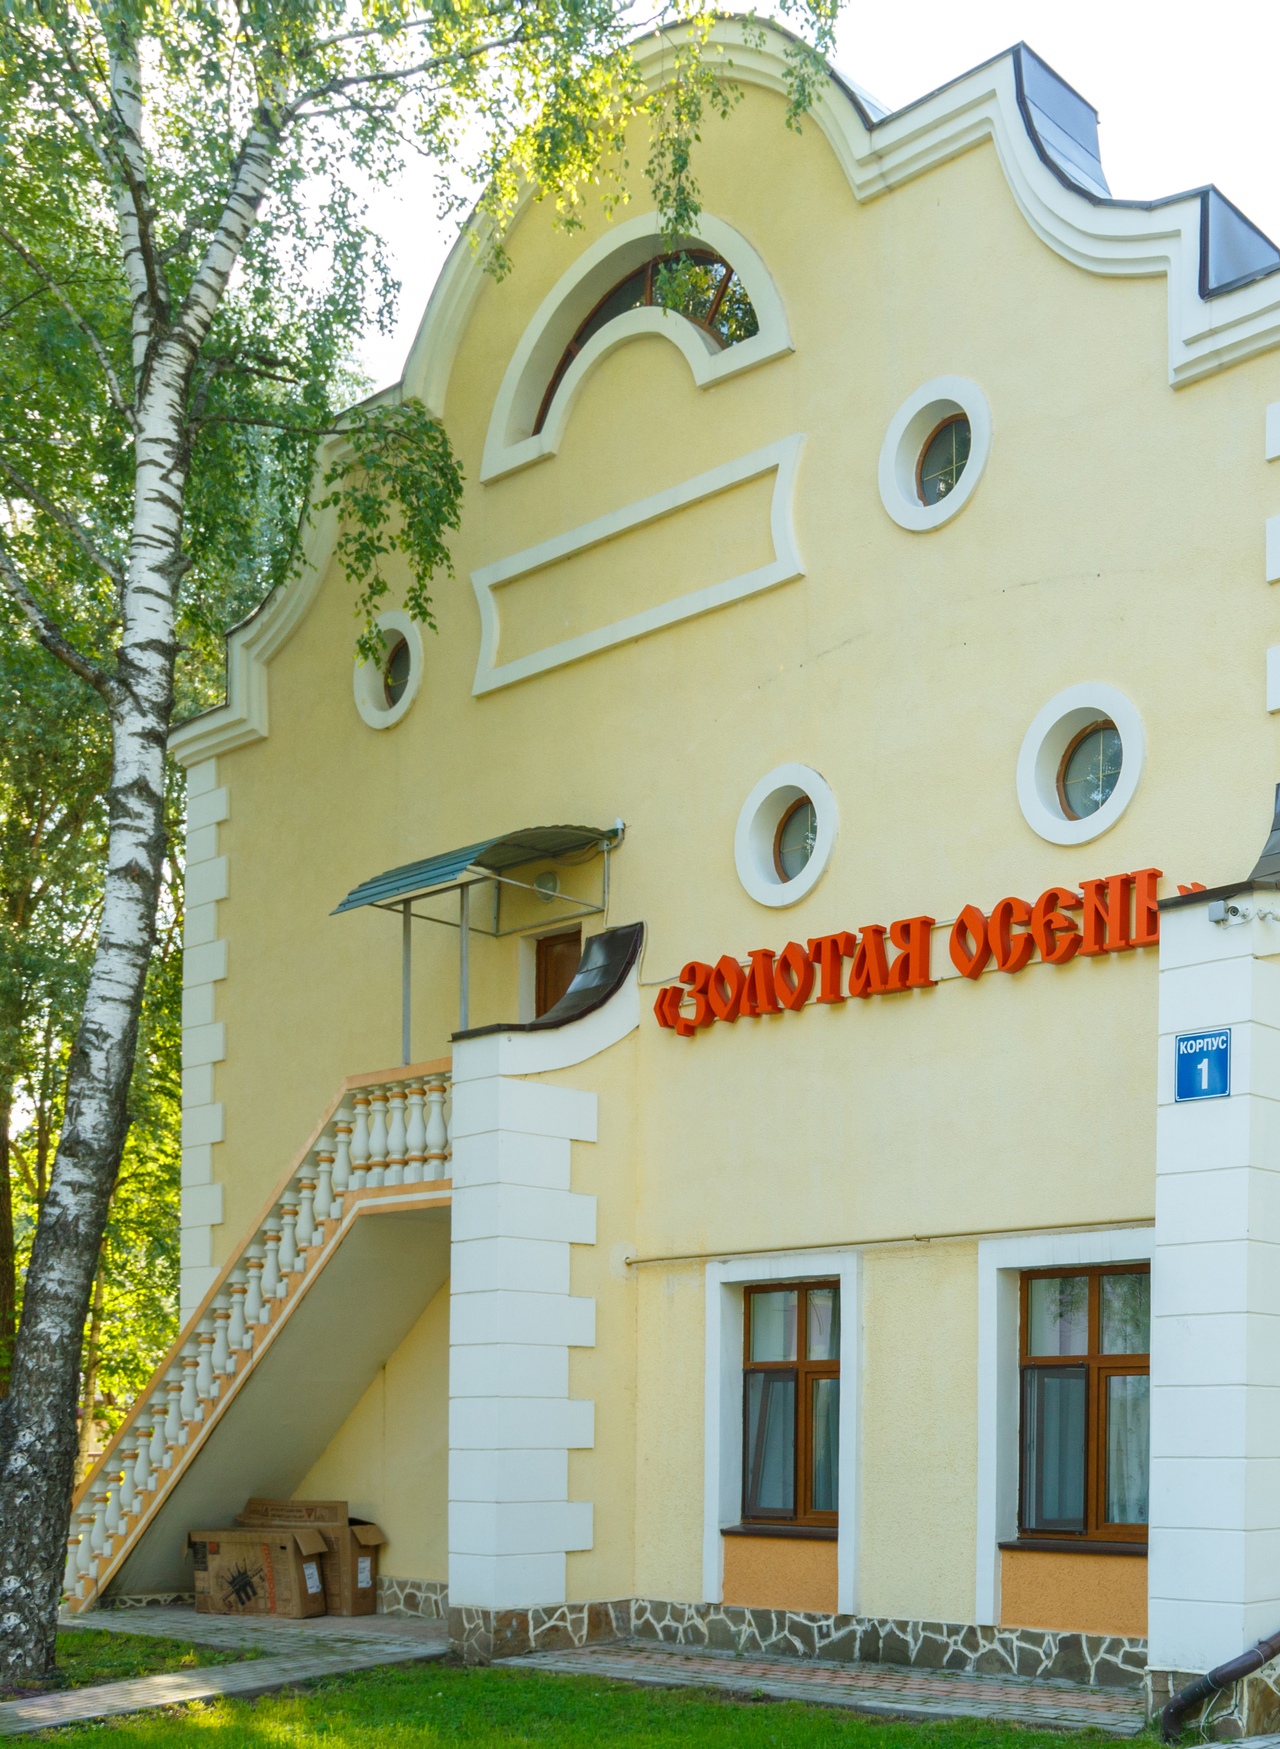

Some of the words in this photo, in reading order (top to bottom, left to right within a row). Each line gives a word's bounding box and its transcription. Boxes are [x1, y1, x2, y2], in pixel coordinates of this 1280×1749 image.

[949, 867, 1207, 980] ОСЕНЬ
[1180, 1035, 1227, 1054] КОРПУС
[1197, 1058, 1209, 1090] 1
